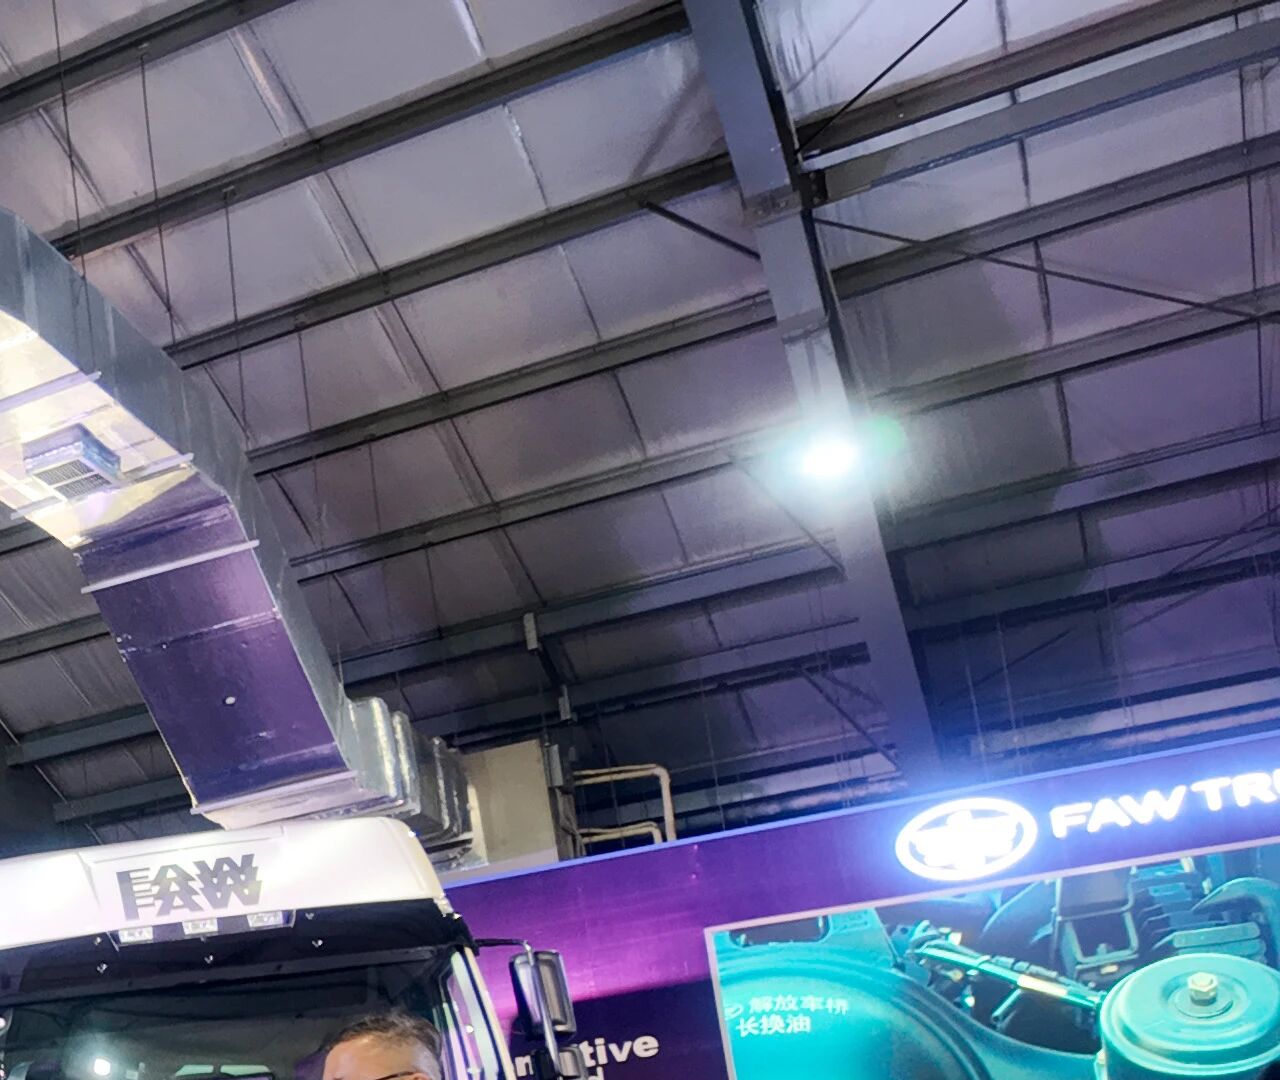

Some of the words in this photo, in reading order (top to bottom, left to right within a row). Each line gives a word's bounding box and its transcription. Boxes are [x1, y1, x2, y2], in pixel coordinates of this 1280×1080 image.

[1049, 785, 1187, 839] FAW
[1190, 768, 1280, 812] TR
[736, 1014, 811, 1037] 长换油
